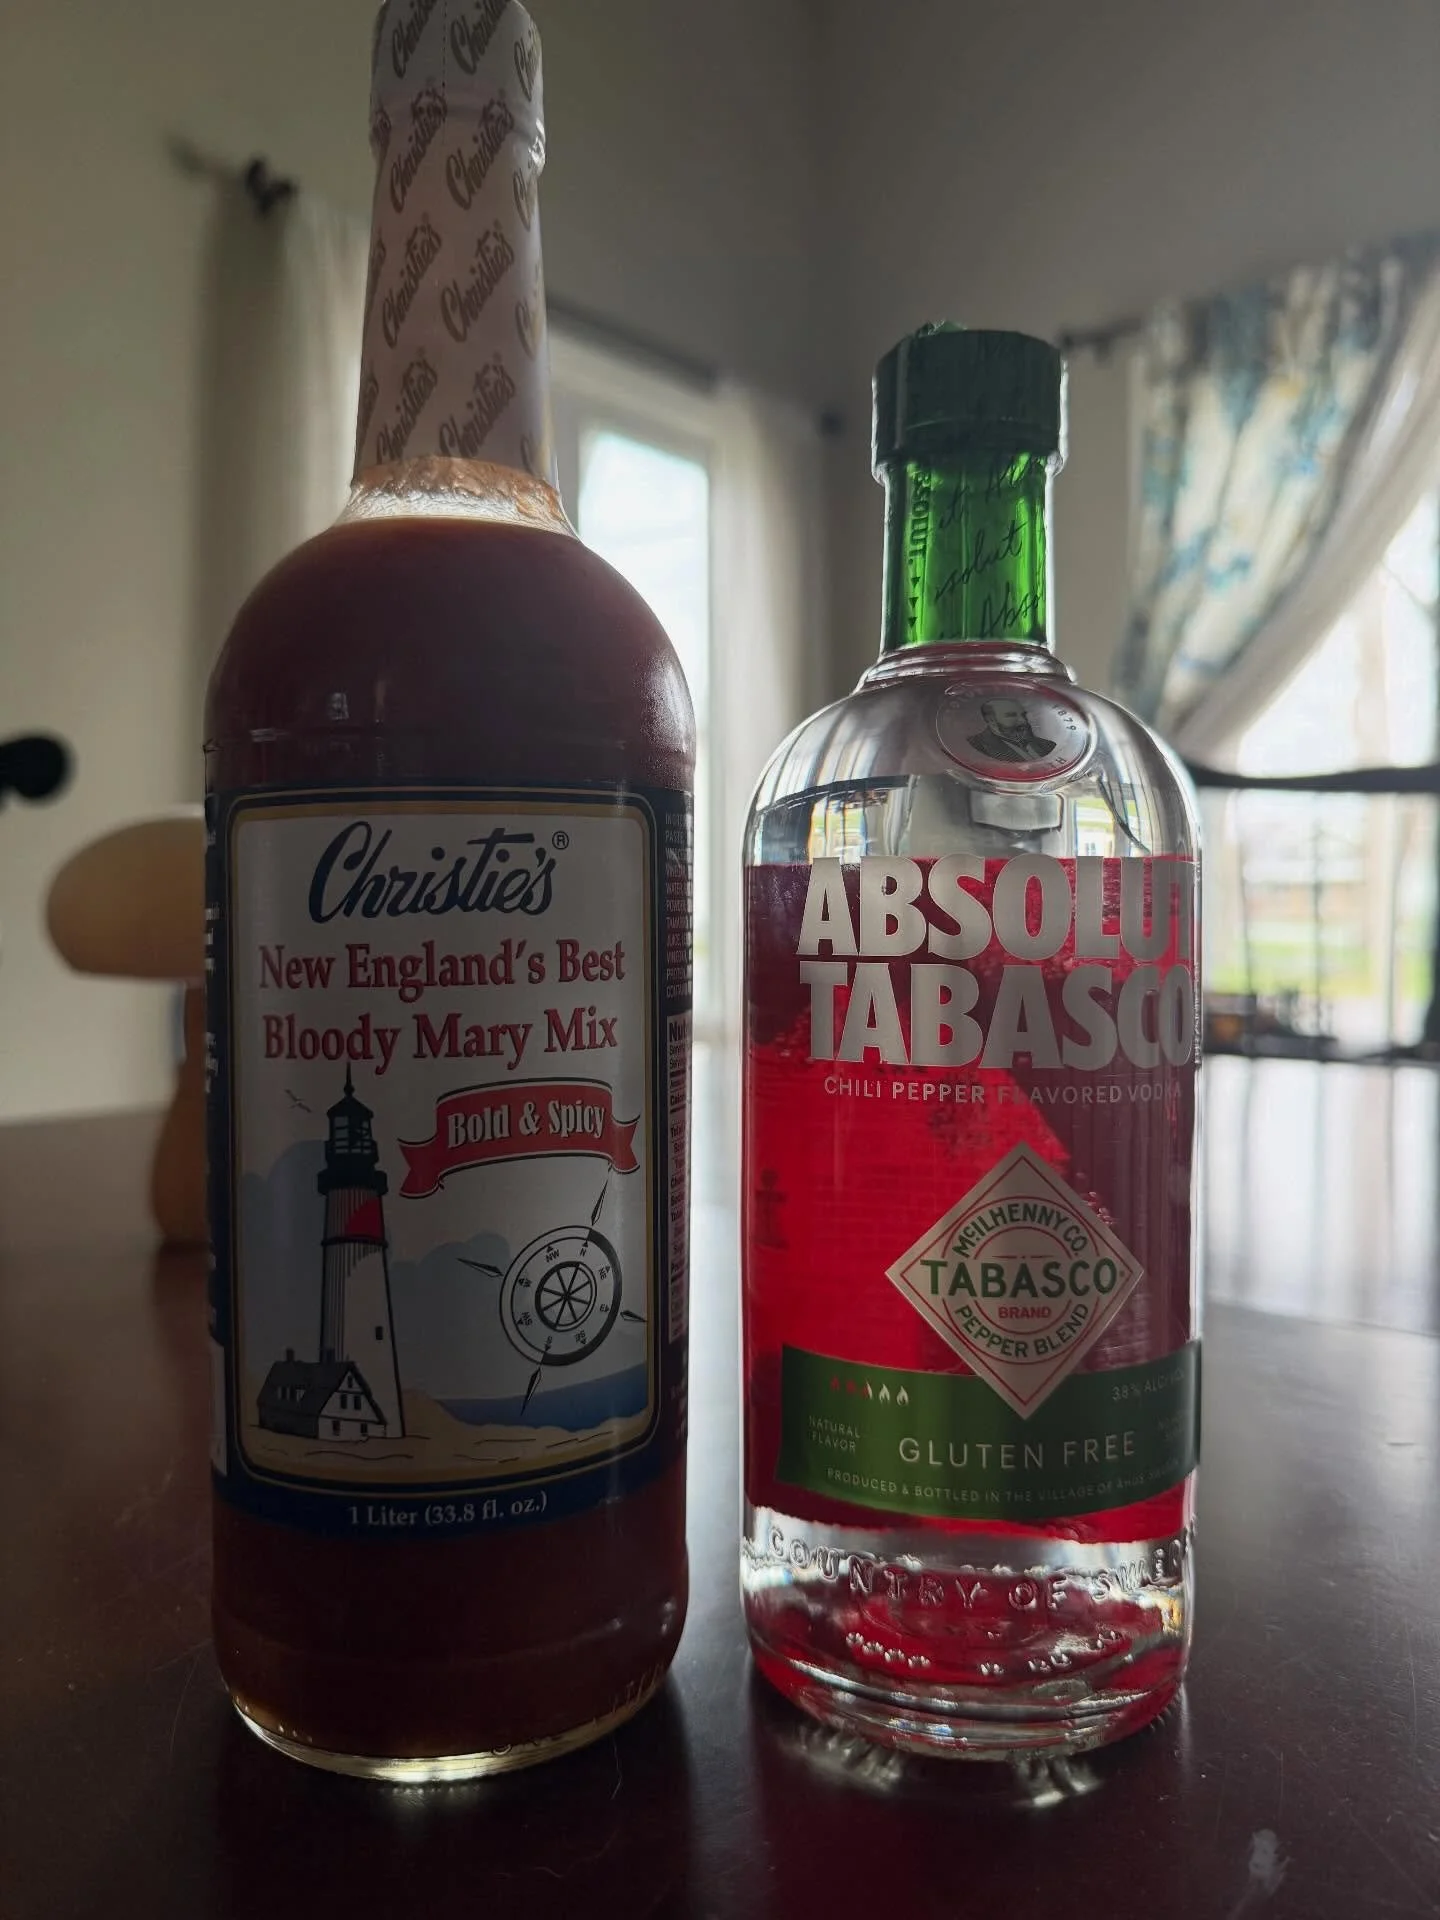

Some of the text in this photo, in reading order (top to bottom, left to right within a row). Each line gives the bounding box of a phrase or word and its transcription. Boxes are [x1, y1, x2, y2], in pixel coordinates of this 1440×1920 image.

[382, 223, 442, 349] Christie's
[440, 228, 515, 343] Christie's
[258, 944, 337, 990] New
[344, 937, 547, 1004] England's
[556, 936, 626, 985] Best
[799, 960, 1193, 1070] TABASCO
[262, 1012, 402, 1076] Bloody
[412, 1011, 534, 1071] Mary
[543, 1005, 619, 1054] Mix
[824, 1075, 1182, 1106] CHILI PEPPER FLAVORED VODKA
[447, 1099, 607, 1150] Bold & Spicy
[919, 1256, 1118, 1300] TABASCO
[954, 1302, 1090, 1358] PEPPER BLEND
[998, 1305, 1053, 1320] BRAND
[808, 1414, 861, 1440] NATURAL
[809, 1430, 858, 1454] FLAVOR
[898, 1436, 1044, 1471] GLUTEN
[1062, 1430, 1136, 1469] FREE
[348, 1489, 549, 1528] 1 Liter (33.8 fl. oz.)
[826, 1467, 898, 1497] PRODUCED
[901, 1485, 910, 1497] &
[914, 1485, 980, 1504] BOTTLED
[985, 1490, 999, 1504] IN
[1004, 1490, 1032, 1503] THE
[1038, 1484, 1095, 1502] VILLAGE
[1096, 1481, 1113, 1495] OF
[769, 1525, 990, 1611] COUNTRY
[1007, 1570, 1069, 1612] OF
